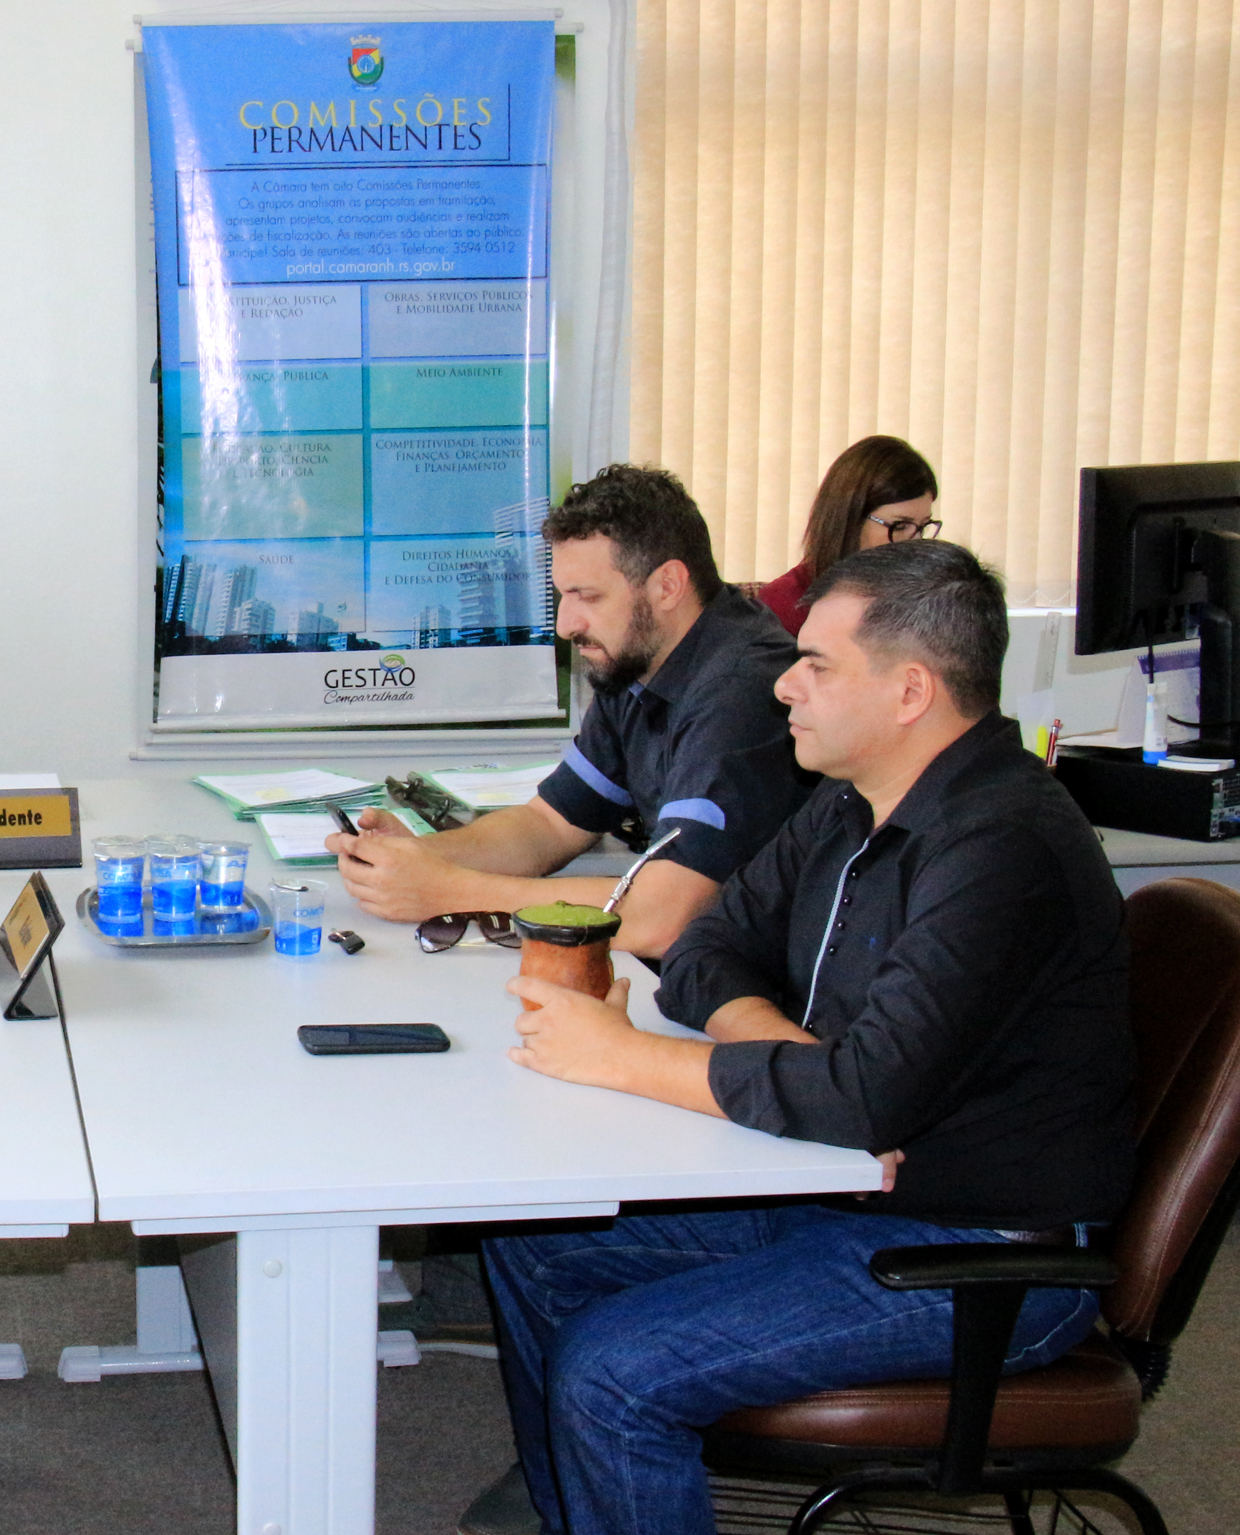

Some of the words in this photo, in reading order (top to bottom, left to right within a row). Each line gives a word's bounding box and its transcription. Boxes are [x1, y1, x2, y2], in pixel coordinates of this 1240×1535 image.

[239, 93, 492, 129] COMISSÕES
[251, 123, 482, 154] PERMANENTES
[251, 182, 260, 193] A
[263, 180, 307, 193] Câmara
[311, 181, 330, 192] tem
[333, 181, 353, 192] oito
[357, 178, 413, 191] Comissões
[238, 197, 255, 210] Os
[257, 200, 295, 213] grupos
[299, 196, 346, 209] analisam
[349, 199, 360, 208] as
[365, 196, 415, 210] propostas
[418, 198, 435, 207] em
[225, 215, 286, 227] apresentam
[290, 214, 334, 228] projetos,
[338, 213, 393, 224] convocam
[396, 209, 453, 223] audiências
[456, 213, 463, 222] e
[466, 209, 510, 222] realizam
[249, 229, 264, 242] de
[337, 228, 351, 240] As
[354, 228, 397, 240] reuniões
[401, 227, 420, 239] são
[423, 226, 462, 239] abertas
[466, 228, 481, 238] ao
[484, 225, 525, 240] público.
[271, 245, 296, 258] Sala
[299, 245, 313, 257] de
[368, 243, 392, 256] 403
[453, 241, 482, 254] 3594
[485, 240, 516, 253] 0512
[286, 256, 455, 279] portal.camaranh.rs.gov.br
[293, 293, 337, 307] JUSTIÇA
[384, 291, 423, 303] OBRAS,
[427, 290, 478, 303] SERVIÇOS
[251, 307, 304, 320] REDAÇÃO
[406, 303, 475, 314] MOBILIDADE
[479, 301, 523, 313] URBANA
[416, 367, 446, 378] MEIO
[449, 366, 503, 377] AMBIENTE
[455, 448, 526, 461] ORÇAMENTO
[424, 461, 507, 474] PLANEJAMENTO
[402, 550, 452, 562] DIREITOS
[427, 560, 490, 573] CIDADANIA
[394, 573, 434, 585] DEFESA
[456, 570, 531, 583] CONSUMIDOR
[323, 689, 416, 706] Compartilhada
